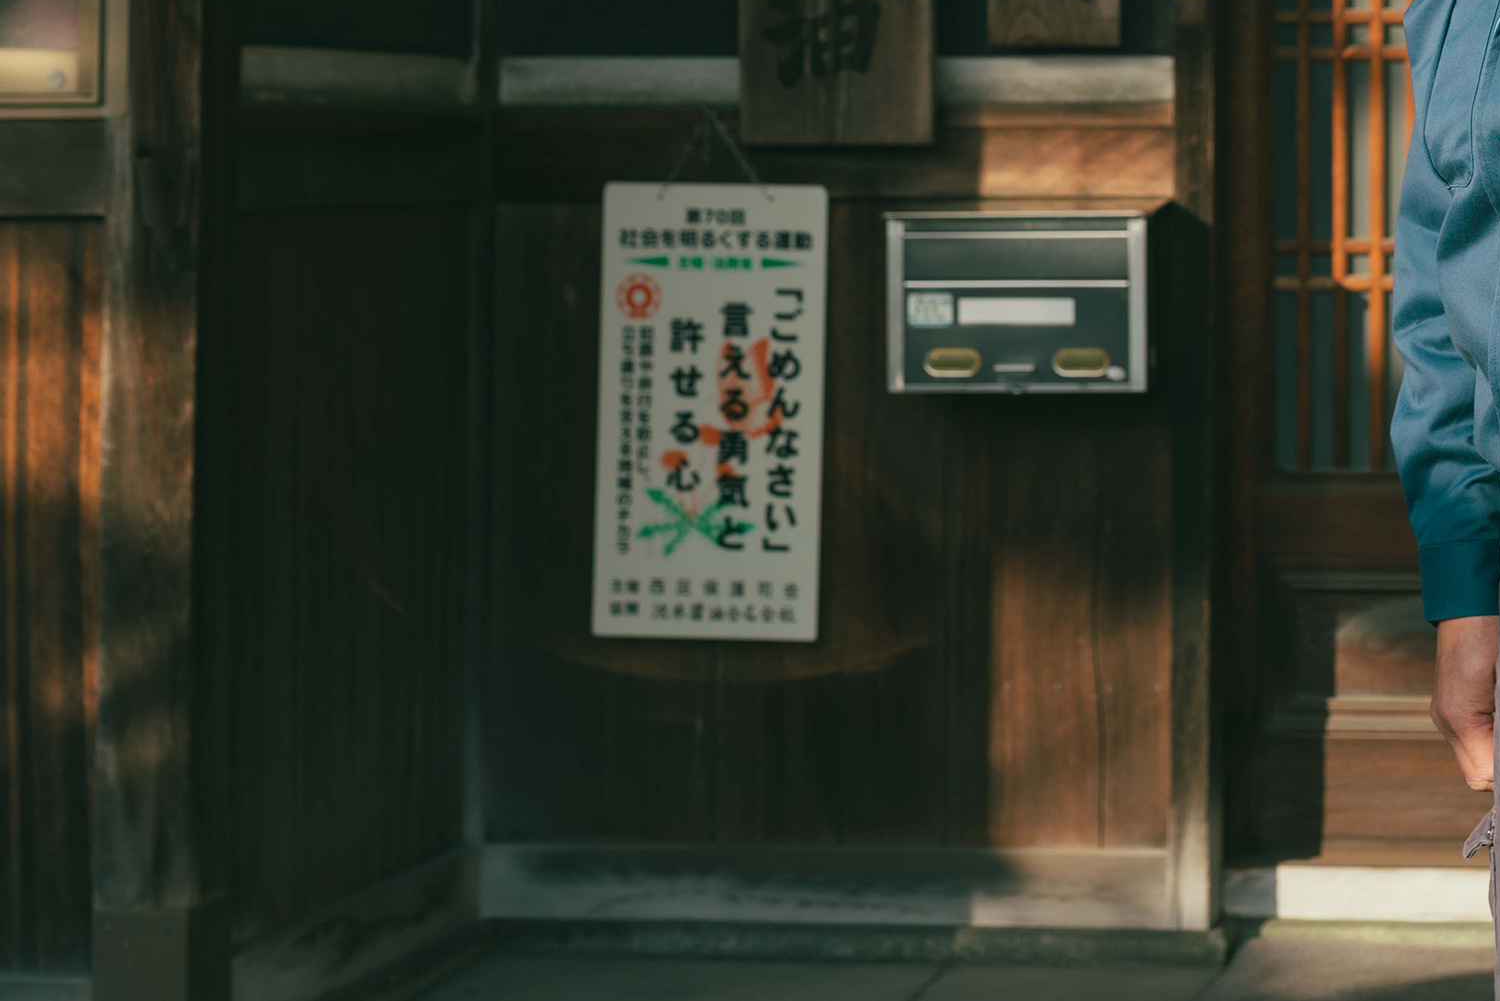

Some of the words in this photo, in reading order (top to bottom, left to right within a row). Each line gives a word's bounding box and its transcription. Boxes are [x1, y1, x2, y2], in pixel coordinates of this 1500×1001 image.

[619, 227, 813, 250] 社会を明るくする運動
[686, 208, 746, 225] 第70回
[666, 317, 704, 493] 許せる心
[716, 302, 755, 553] 言える勇気と
[762, 287, 805, 555] 「ごめんなさい」
